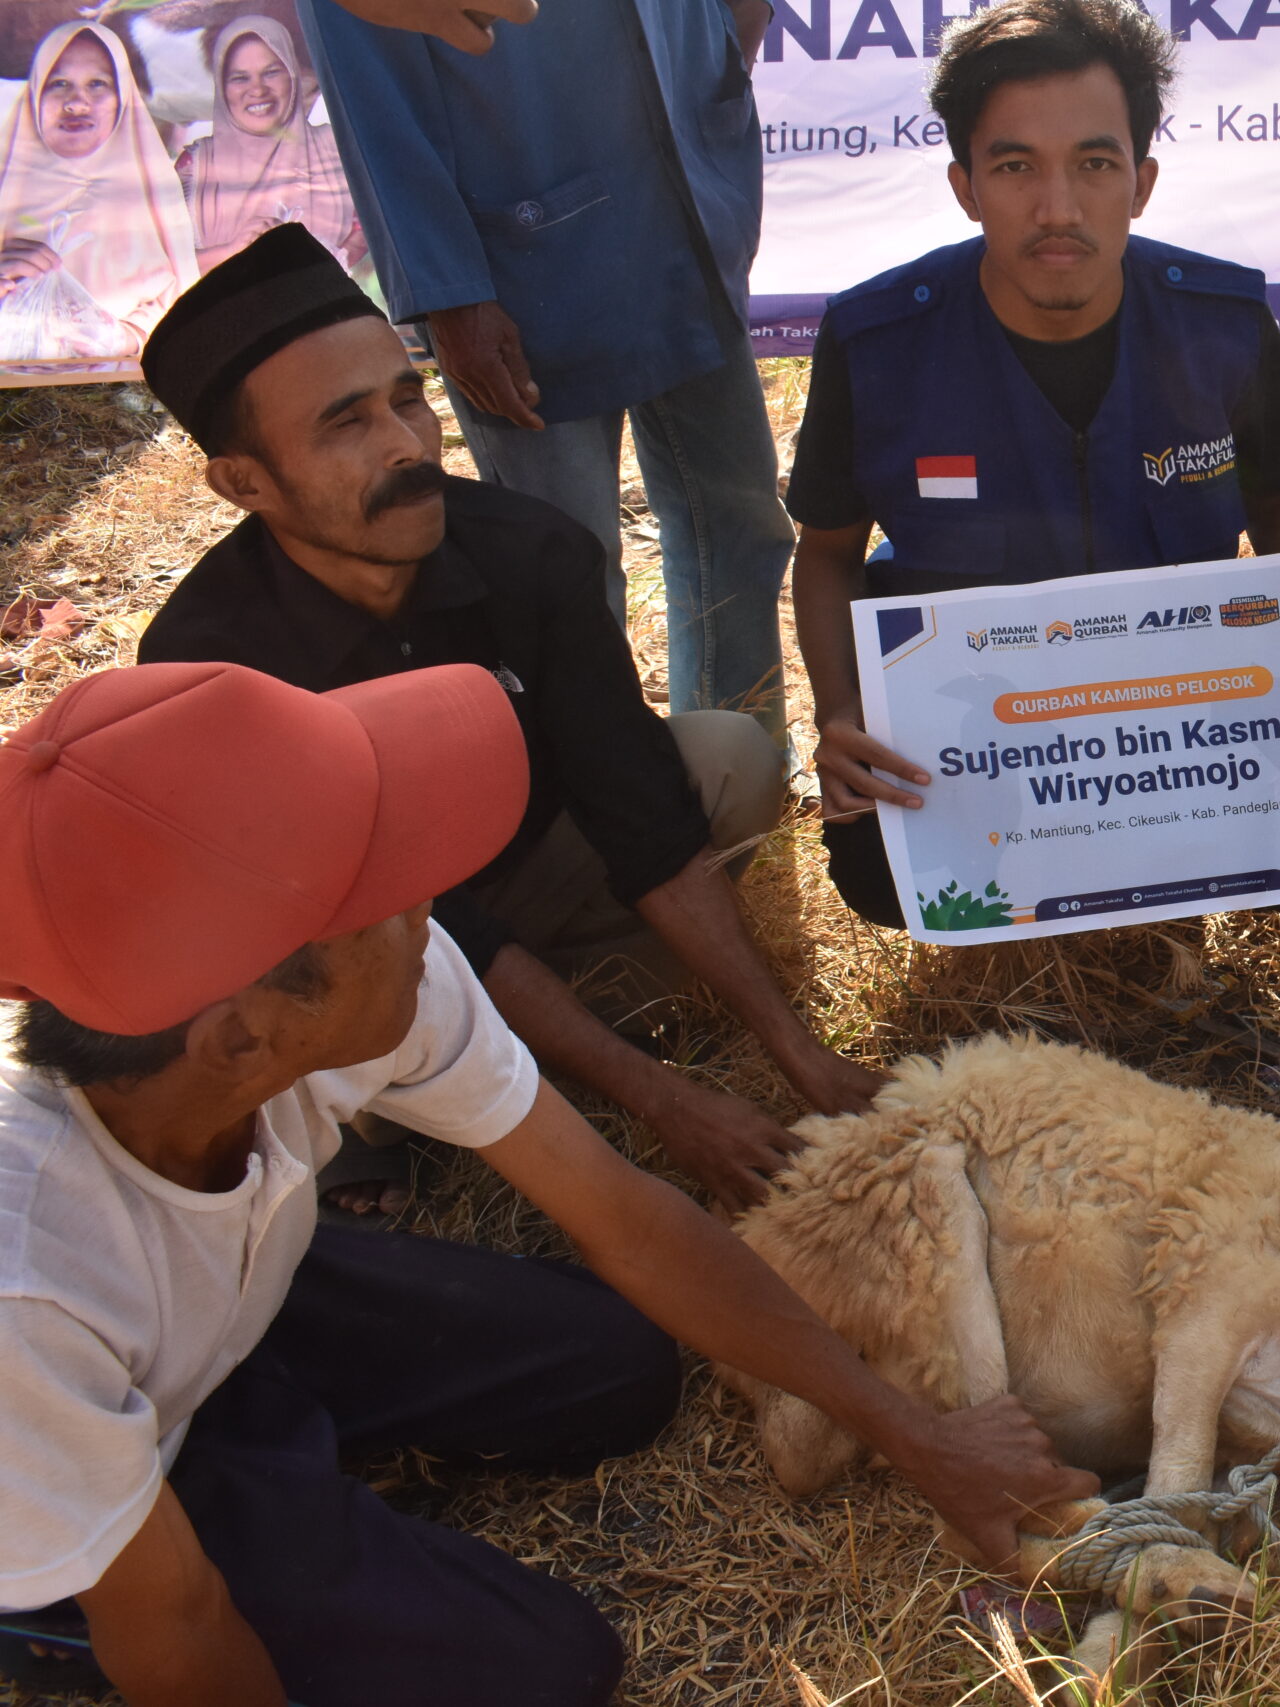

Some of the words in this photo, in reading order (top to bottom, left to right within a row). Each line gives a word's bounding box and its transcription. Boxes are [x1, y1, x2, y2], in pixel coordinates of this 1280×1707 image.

[756, 0, 989, 62] NAH
[1177, 433, 1233, 458] AMANAH
[1176, 448, 1235, 472] TAKAFUL
[1220, 600, 1277, 613] BERQURBAN
[990, 625, 1037, 636] AMANAH
[1073, 614, 1126, 627] AMANAH
[1074, 624, 1127, 637] QURBAN
[990, 634, 1039, 646] TAKAFUL
[1012, 692, 1086, 715] QURBAN
[1090, 684, 1173, 707] KAMBING
[1177, 675, 1255, 696] PELOSOK
[938, 734, 1106, 780] Sujendro
[1115, 725, 1171, 757] bin
[1028, 753, 1261, 806] Wiryoatmojo
[1005, 830, 1027, 845] Kp.
[1030, 821, 1095, 841] Mantiung,
[1098, 818, 1126, 832] Kec.
[1128, 810, 1182, 827] Cikeusik
[1192, 806, 1220, 820] Kab.
